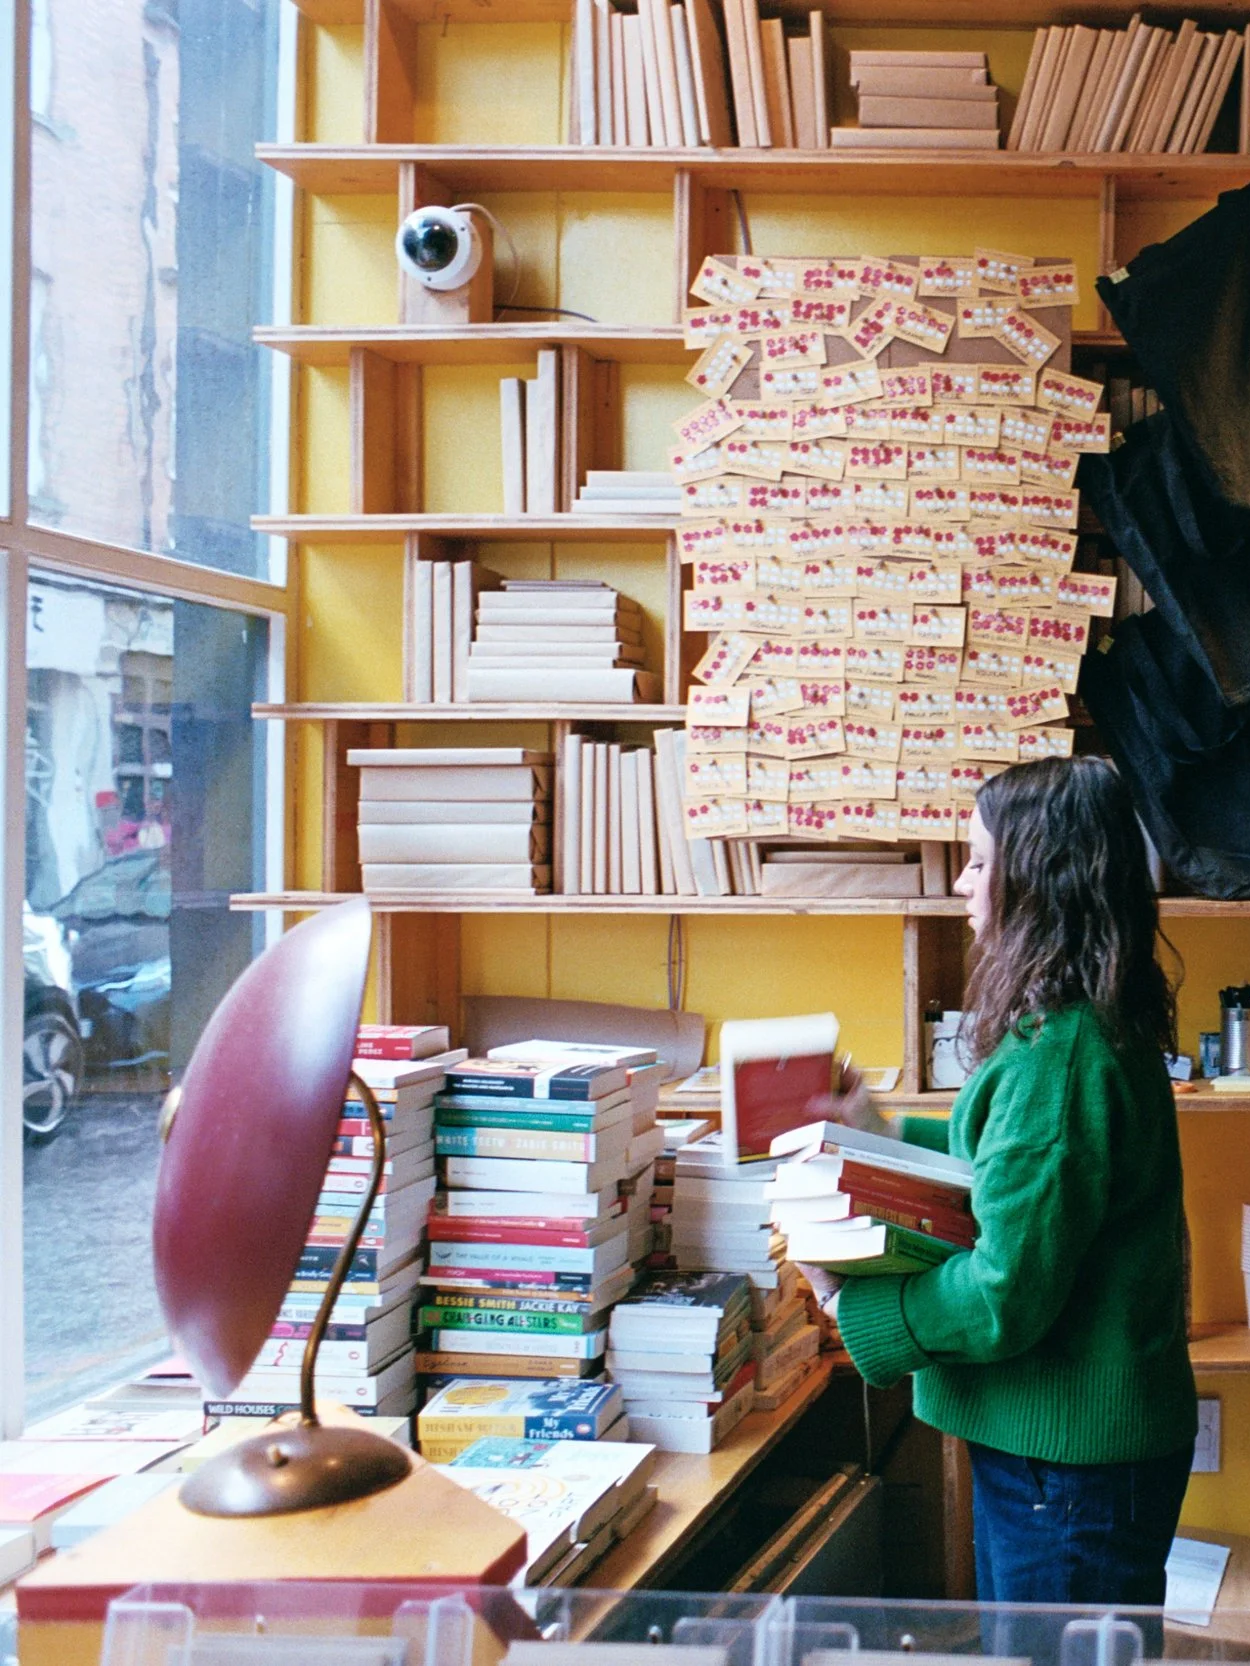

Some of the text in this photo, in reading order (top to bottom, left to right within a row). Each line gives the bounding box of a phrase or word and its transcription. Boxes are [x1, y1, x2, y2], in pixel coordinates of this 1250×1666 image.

[435, 1295, 580, 1314] BESSIE SMITH JACKIE KAY
[208, 1403, 276, 1415] WILD HOUSES
[542, 1417, 561, 1429] My
[528, 1426, 574, 1440] Friends
